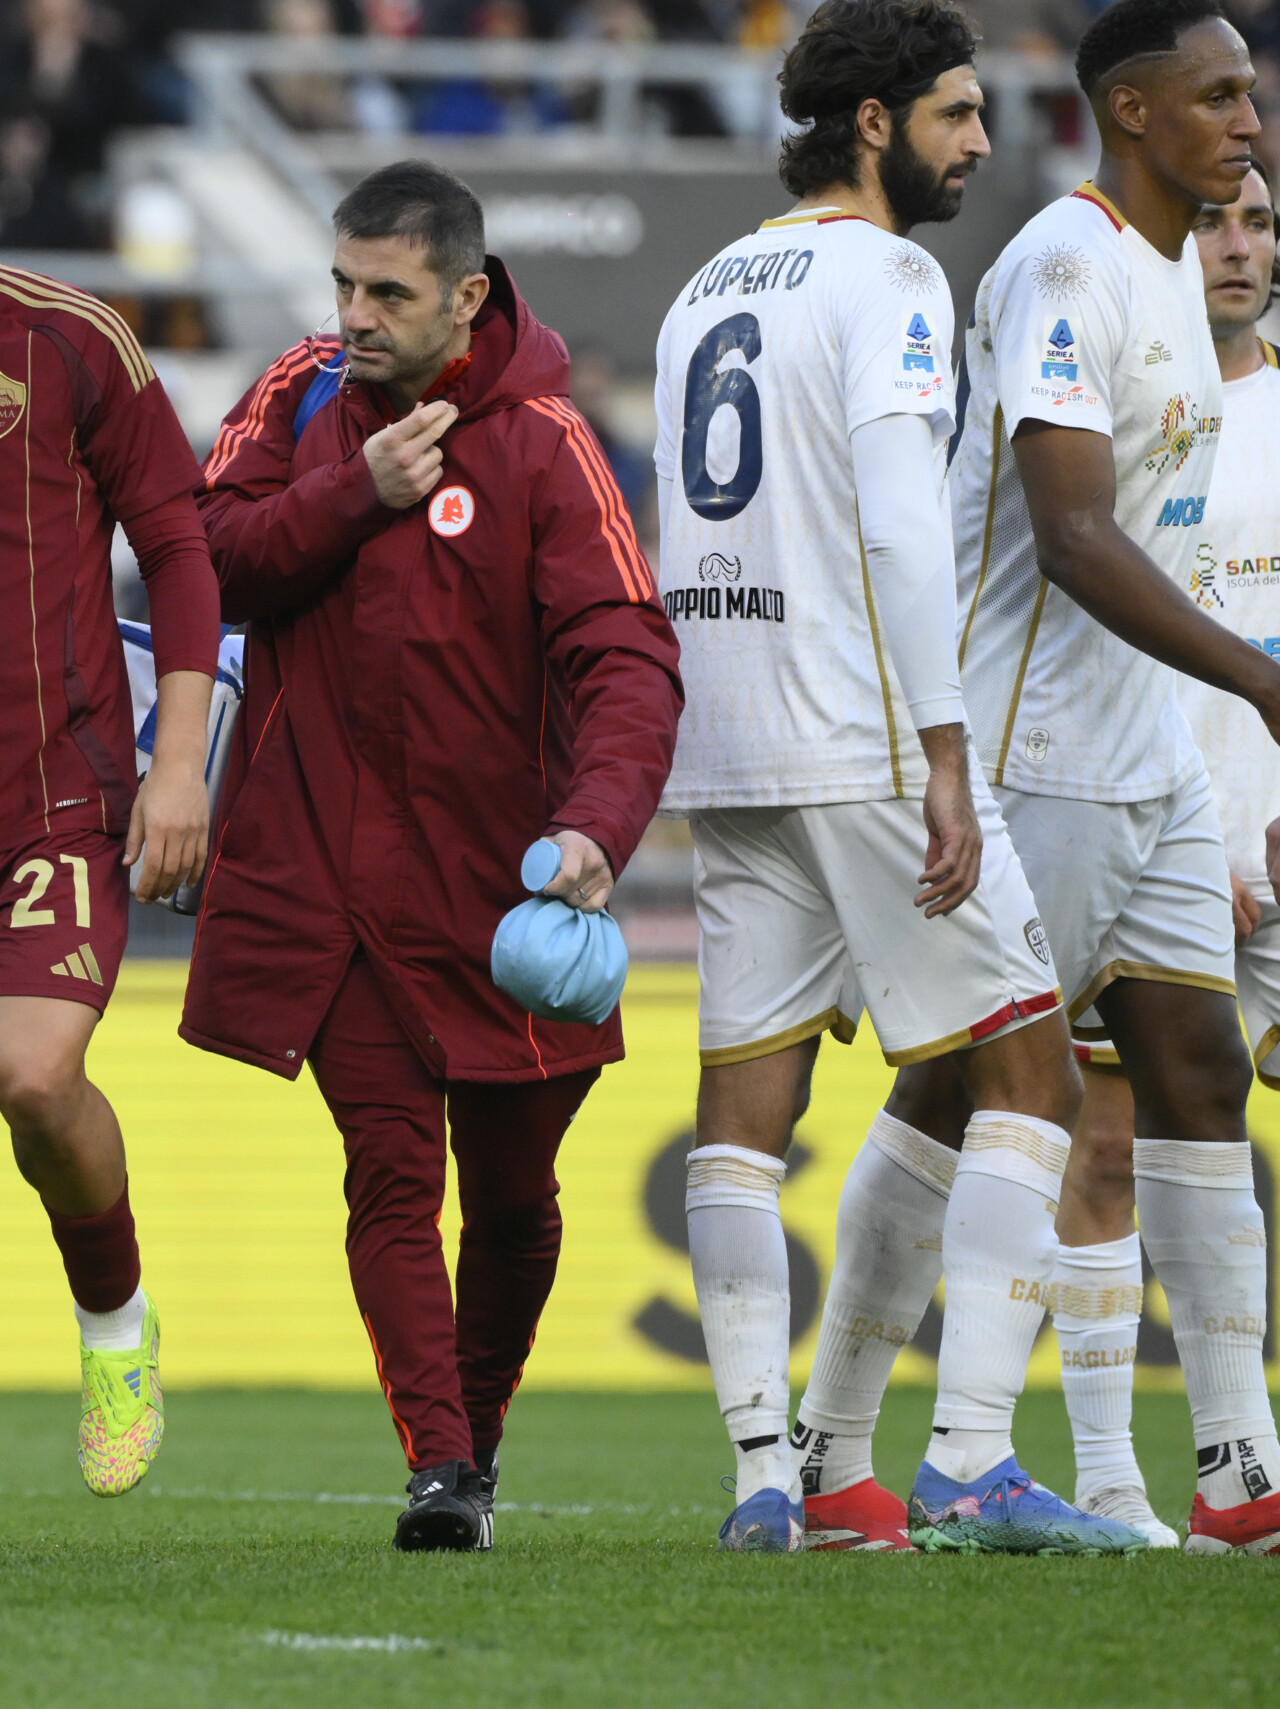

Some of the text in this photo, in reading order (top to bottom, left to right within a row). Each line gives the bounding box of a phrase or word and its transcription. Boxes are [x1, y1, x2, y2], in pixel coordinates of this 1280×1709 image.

[687, 248, 815, 307] LUPERTO
[906, 341, 926, 350] SERIE
[1046, 350, 1067, 358] SERIE
[894, 380, 944, 392] KEEP RACIS
[1031, 386, 1099, 406] KEEP RACISM OUT
[681, 312, 763, 522] 6
[1227, 578, 1260, 589] ISOLA
[663, 587, 784, 623] OPPIO MALTO
[10, 853, 91, 929] 21
